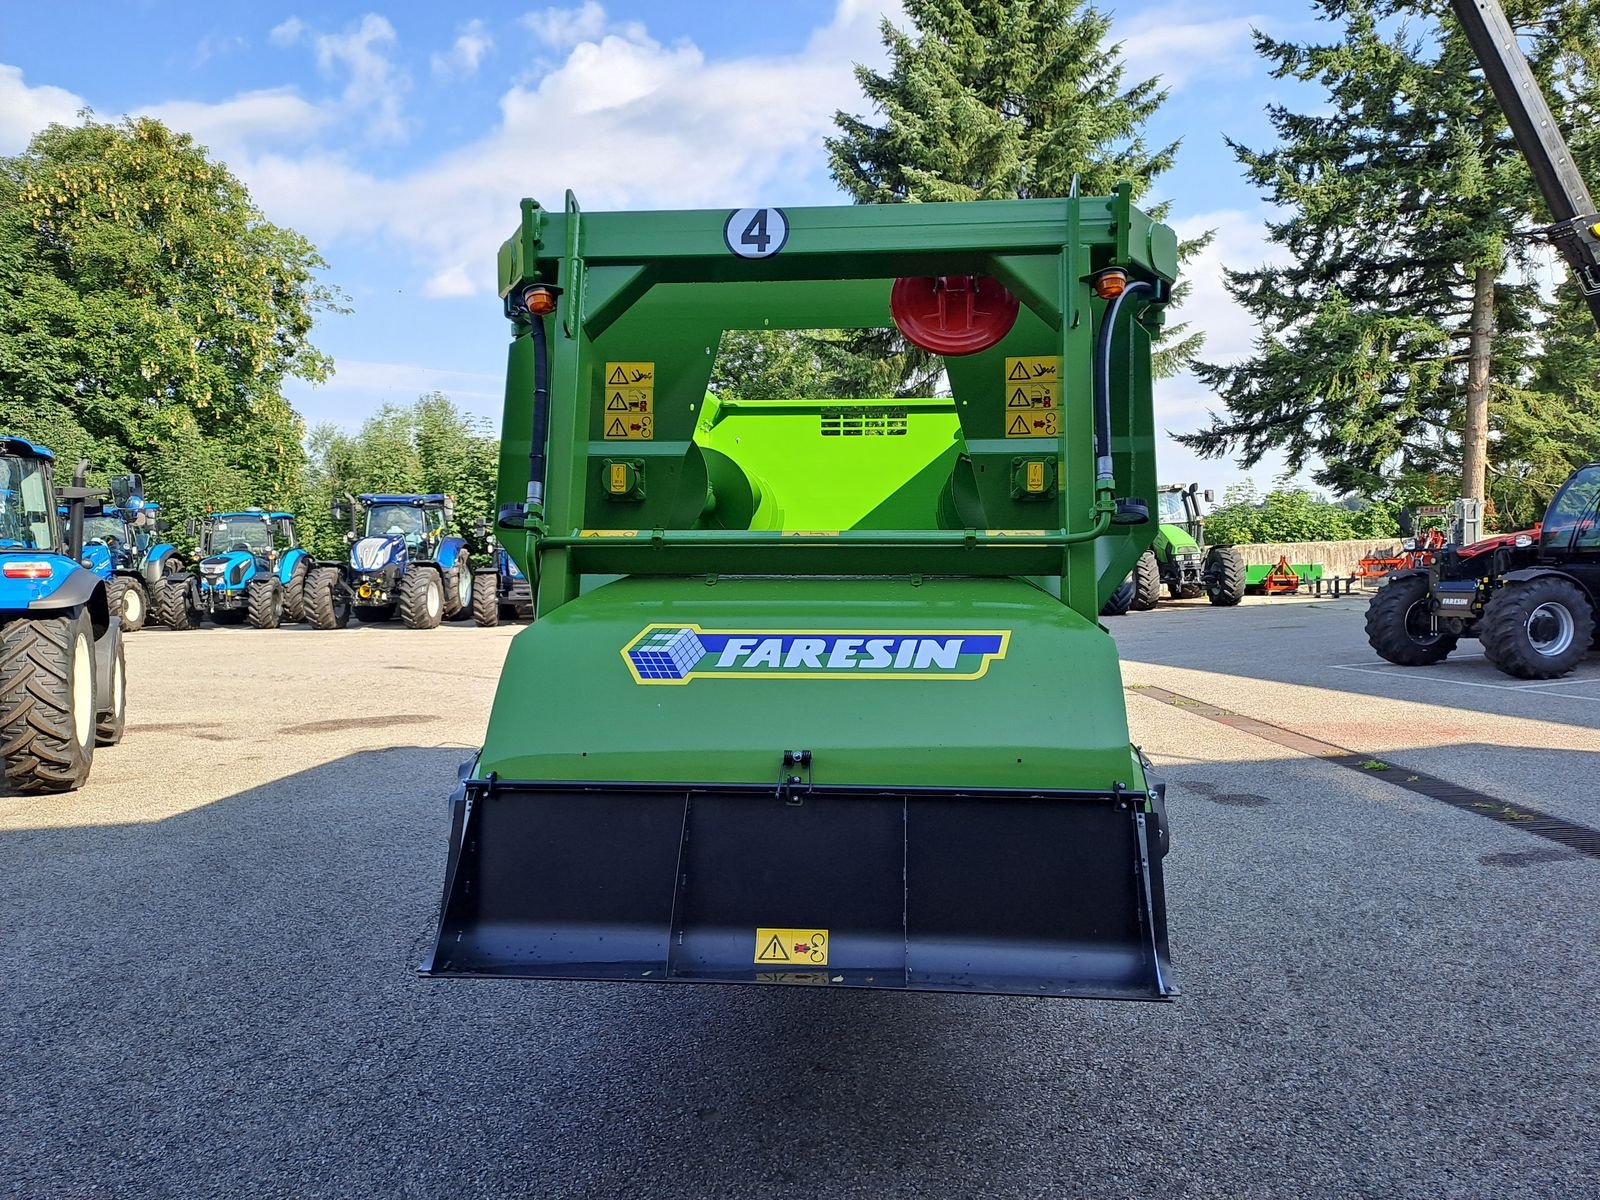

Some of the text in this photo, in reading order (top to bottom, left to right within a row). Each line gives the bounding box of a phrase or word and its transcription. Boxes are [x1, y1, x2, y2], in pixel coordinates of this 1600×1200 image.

[741, 208, 770, 252] 4
[1442, 597, 1469, 605] FARESIN
[714, 638, 965, 669] FARESIN
